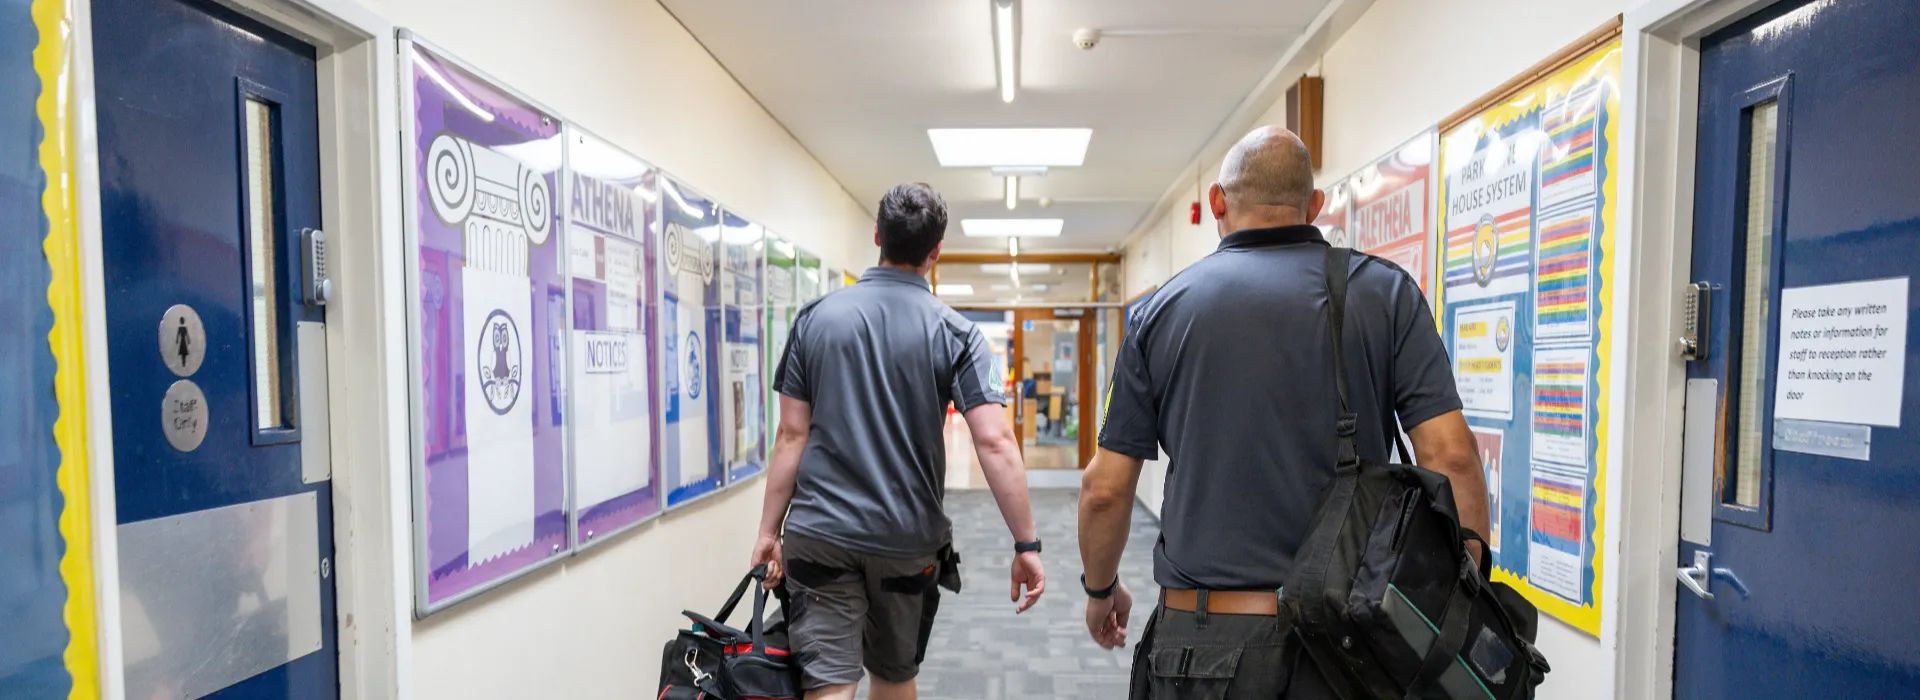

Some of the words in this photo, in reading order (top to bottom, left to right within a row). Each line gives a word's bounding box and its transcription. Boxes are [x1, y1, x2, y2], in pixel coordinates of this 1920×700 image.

[1461, 157, 1486, 187] PARK
[570, 170, 636, 238] ATHENA
[1451, 187, 1484, 217] HOUSE
[1485, 170, 1527, 205] SYSTEM
[1358, 189, 1412, 251] ALETHEIA
[1791, 308, 1816, 319] Please
[1818, 306, 1836, 318] take
[1837, 307, 1852, 318] any
[1854, 303, 1887, 315] written
[1790, 329, 1812, 340] notes
[1813, 330, 1822, 339] or
[1823, 325, 1872, 340] information
[1873, 324, 1888, 340] for
[587, 340, 627, 369] NOTICES
[1789, 348, 1808, 362] staff
[1808, 349, 1817, 359] to
[1818, 348, 1857, 361] reception
[1858, 346, 1887, 359] rather
[1788, 369, 1806, 380] than
[1806, 369, 1843, 383] knocking
[1844, 371, 1856, 381] on
[1857, 369, 1873, 381] the
[1786, 390, 1804, 401] door
